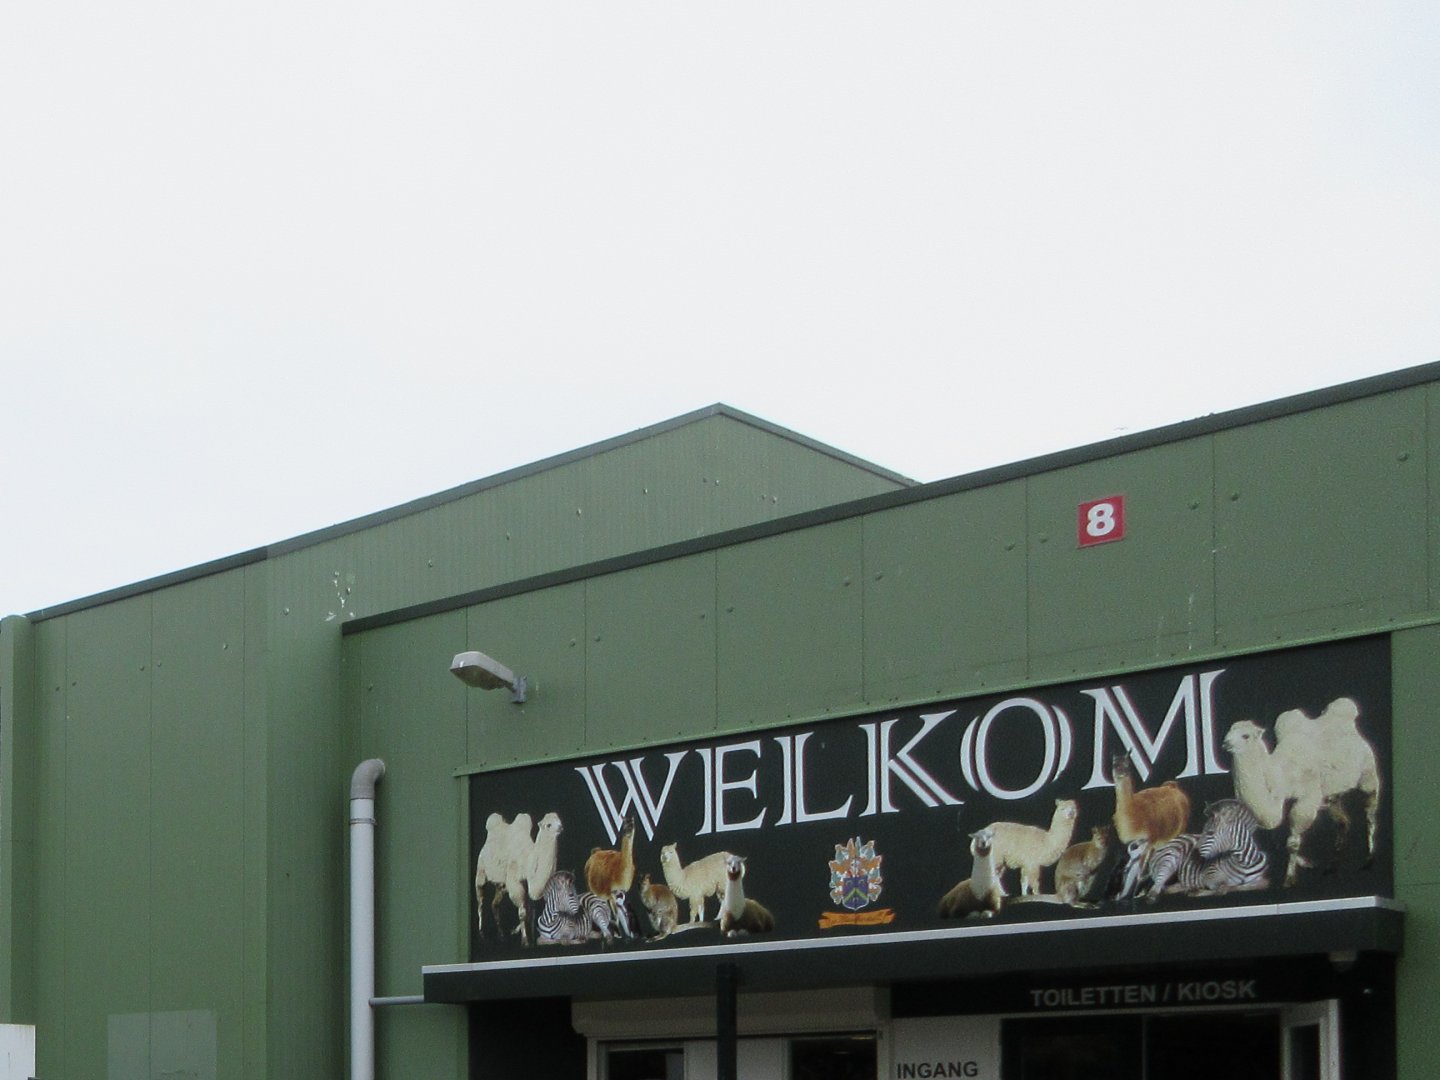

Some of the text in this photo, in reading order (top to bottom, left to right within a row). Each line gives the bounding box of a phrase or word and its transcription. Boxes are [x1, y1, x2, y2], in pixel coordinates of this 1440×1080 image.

[1086, 503, 1116, 537] 8
[574, 669, 1229, 846] WELKOM
[1030, 984, 1155, 1007] TOILETTEN
[1177, 980, 1257, 1001] KIOSK
[897, 1061, 978, 1079] INGANG
